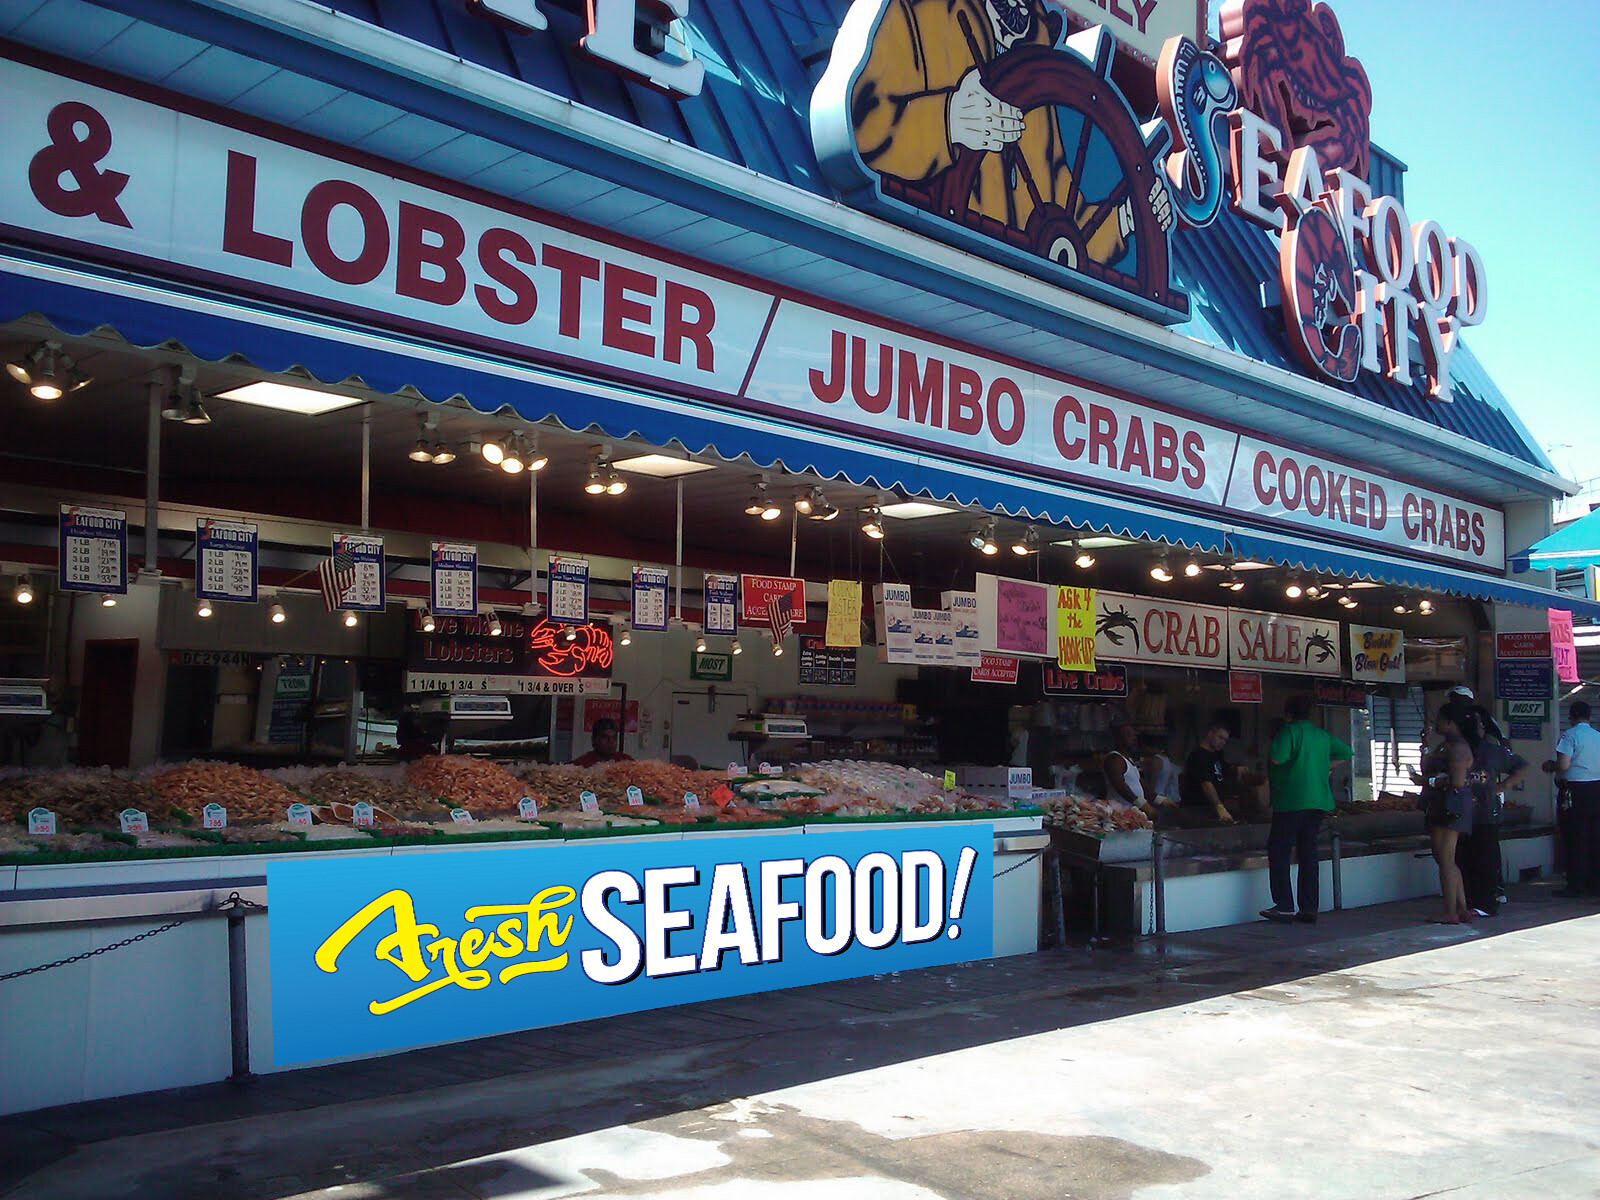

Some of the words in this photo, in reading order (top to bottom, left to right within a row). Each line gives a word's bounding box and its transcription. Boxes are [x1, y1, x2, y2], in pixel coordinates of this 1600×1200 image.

[28, 101, 133, 229] &
[223, 150, 716, 373] LOBSTER
[809, 331, 1026, 448] JUMBO
[1053, 395, 1207, 491] CRABS
[1253, 451, 1388, 532] COOKED
[1402, 493, 1486, 557] CRABS
[752, 579, 772, 589] FOOD
[774, 581, 796, 590] STAMP
[885, 590, 910, 601] JUMBO
[953, 597, 976, 608] JUMBO
[912, 611, 932, 620] JUMBO
[933, 613, 951, 621] JUMBO
[1067, 612, 1082, 628] the
[1143, 609, 1221, 658] CRAB
[1238, 619, 1302, 664] SALE
[424, 640, 514, 664] Lobsters
[699, 658, 725, 670] MOST
[981, 657, 995, 665] FOOD
[995, 658, 1012, 666] STAMP
[974, 668, 990, 676] CARDS
[991, 669, 1016, 678] ACCEPTED
[1046, 667, 1078, 689] Live
[420, 680, 435, 690] 1/4
[438, 680, 447, 690] to
[456, 680, 473, 690] 3/4
[528, 682, 541, 692] 3/4
[543, 682, 550, 692] &
[552, 682, 574, 692] OVER
[1512, 703, 1542, 713] MOST
[1010, 774, 1030, 784] JUMBO
[314, 885, 577, 1016] Fresh
[581, 845, 979, 986] SEAFOOD!
